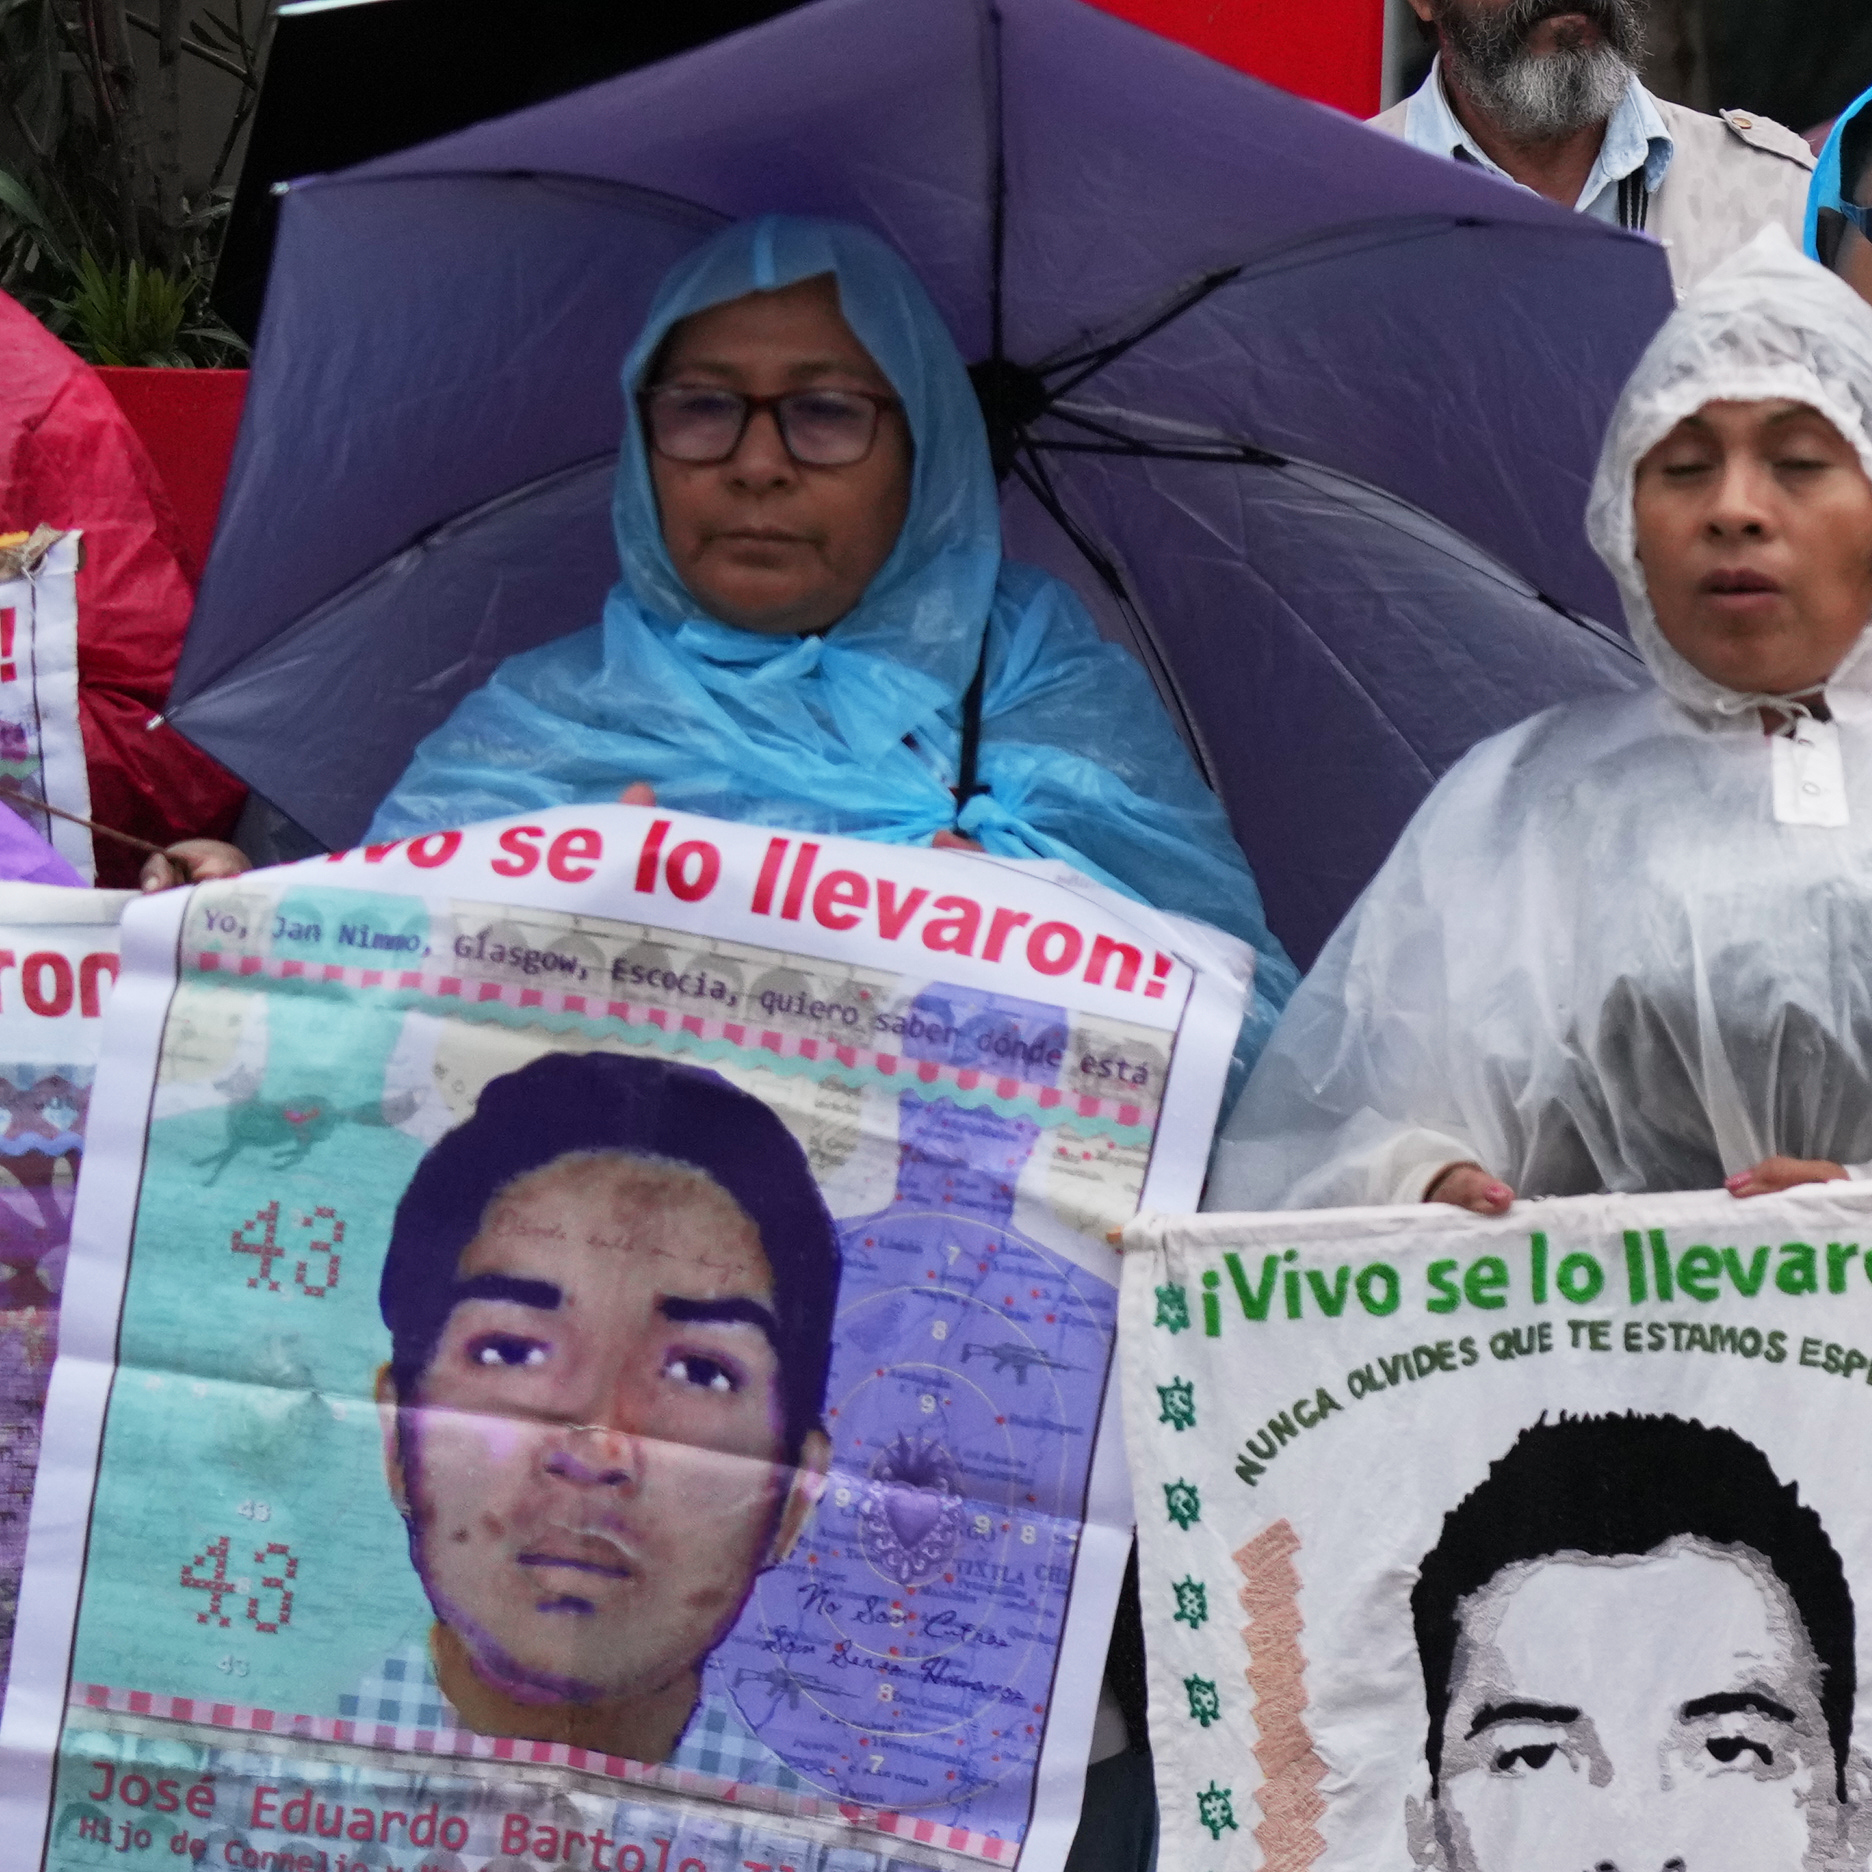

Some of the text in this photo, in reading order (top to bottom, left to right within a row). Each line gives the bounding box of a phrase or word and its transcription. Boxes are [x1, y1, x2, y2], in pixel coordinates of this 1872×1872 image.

[490, 825, 603, 884] se
[634, 819, 722, 903] lo
[750, 837, 1174, 1000] llevaron!
[203, 908, 1150, 1086] Yo, Jan Nimmo, Glasgow, Escocia, quiero saber dónde está
[231, 1200, 348, 1298] 43
[1201, 1249, 1400, 1337] ¡Vivo
[1426, 1255, 1510, 1314] se
[1530, 1231, 1604, 1304] lo
[1235, 1388, 1345, 1487] NUNCA
[1347, 1336, 1480, 1400] OLVIDES
[1488, 1322, 1553, 1362] QUE
[1566, 1319, 1612, 1352] TE
[1624, 1321, 1788, 1364] ESTAMOS
[180, 1536, 298, 1633] 43
[79, 1816, 153, 1853] Hijo
[169, 1830, 207, 1860] de
[89, 1762, 217, 1819] José
[251, 1786, 469, 1851] Eduardo
